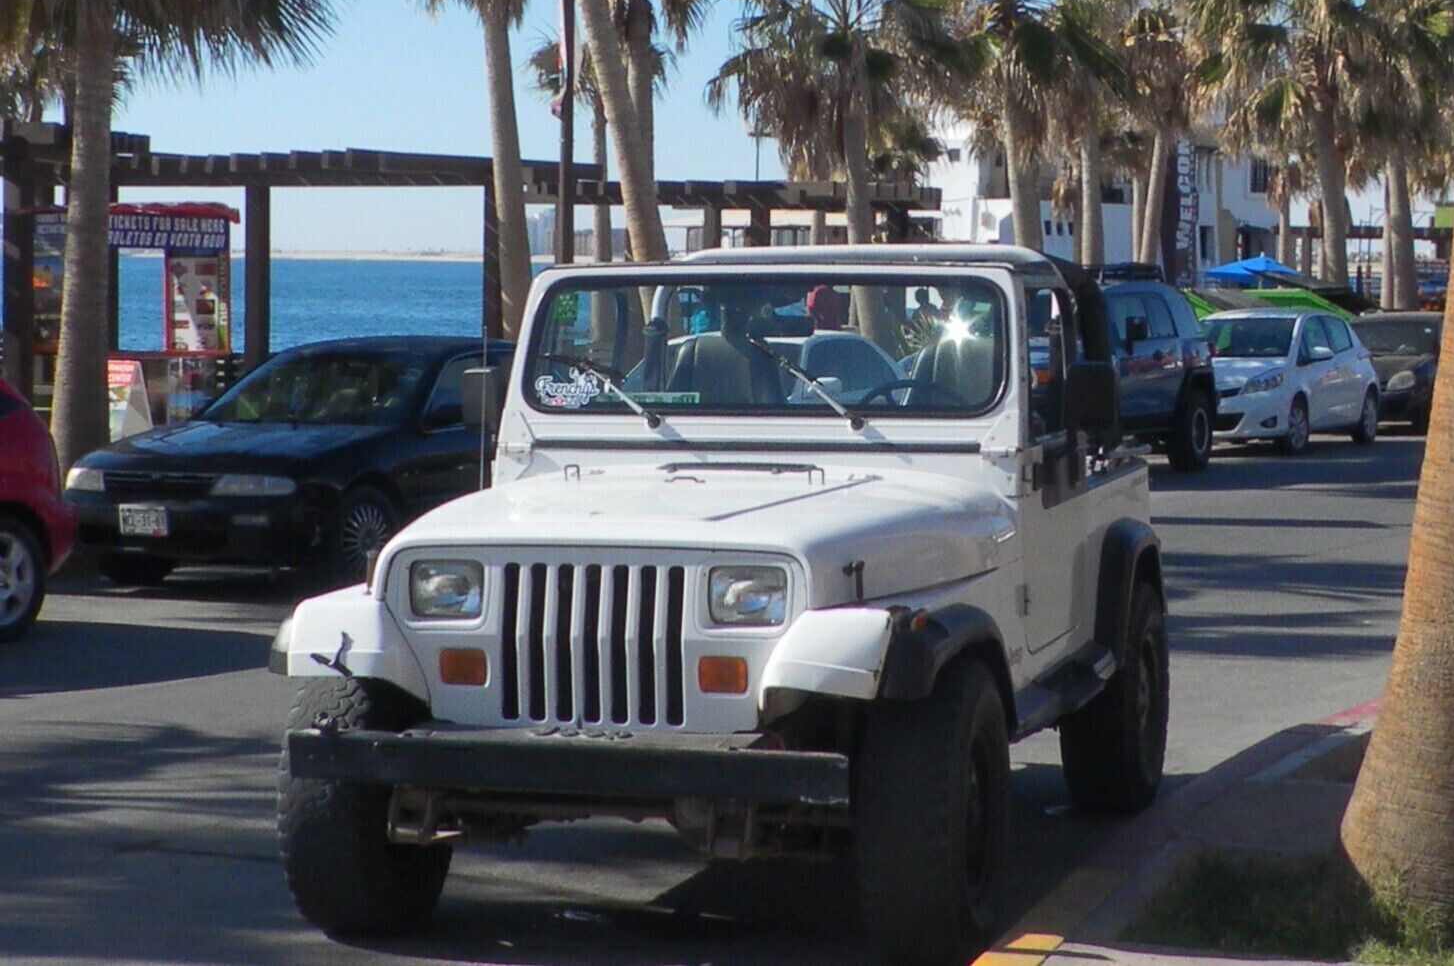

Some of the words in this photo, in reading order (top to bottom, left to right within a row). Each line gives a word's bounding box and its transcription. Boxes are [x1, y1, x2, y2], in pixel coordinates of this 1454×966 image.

[108, 215, 150, 231] TICKETS
[153, 216, 172, 232] FOR
[173, 217, 199, 233] SALE
[1176, 138, 1193, 250] WELCOM
